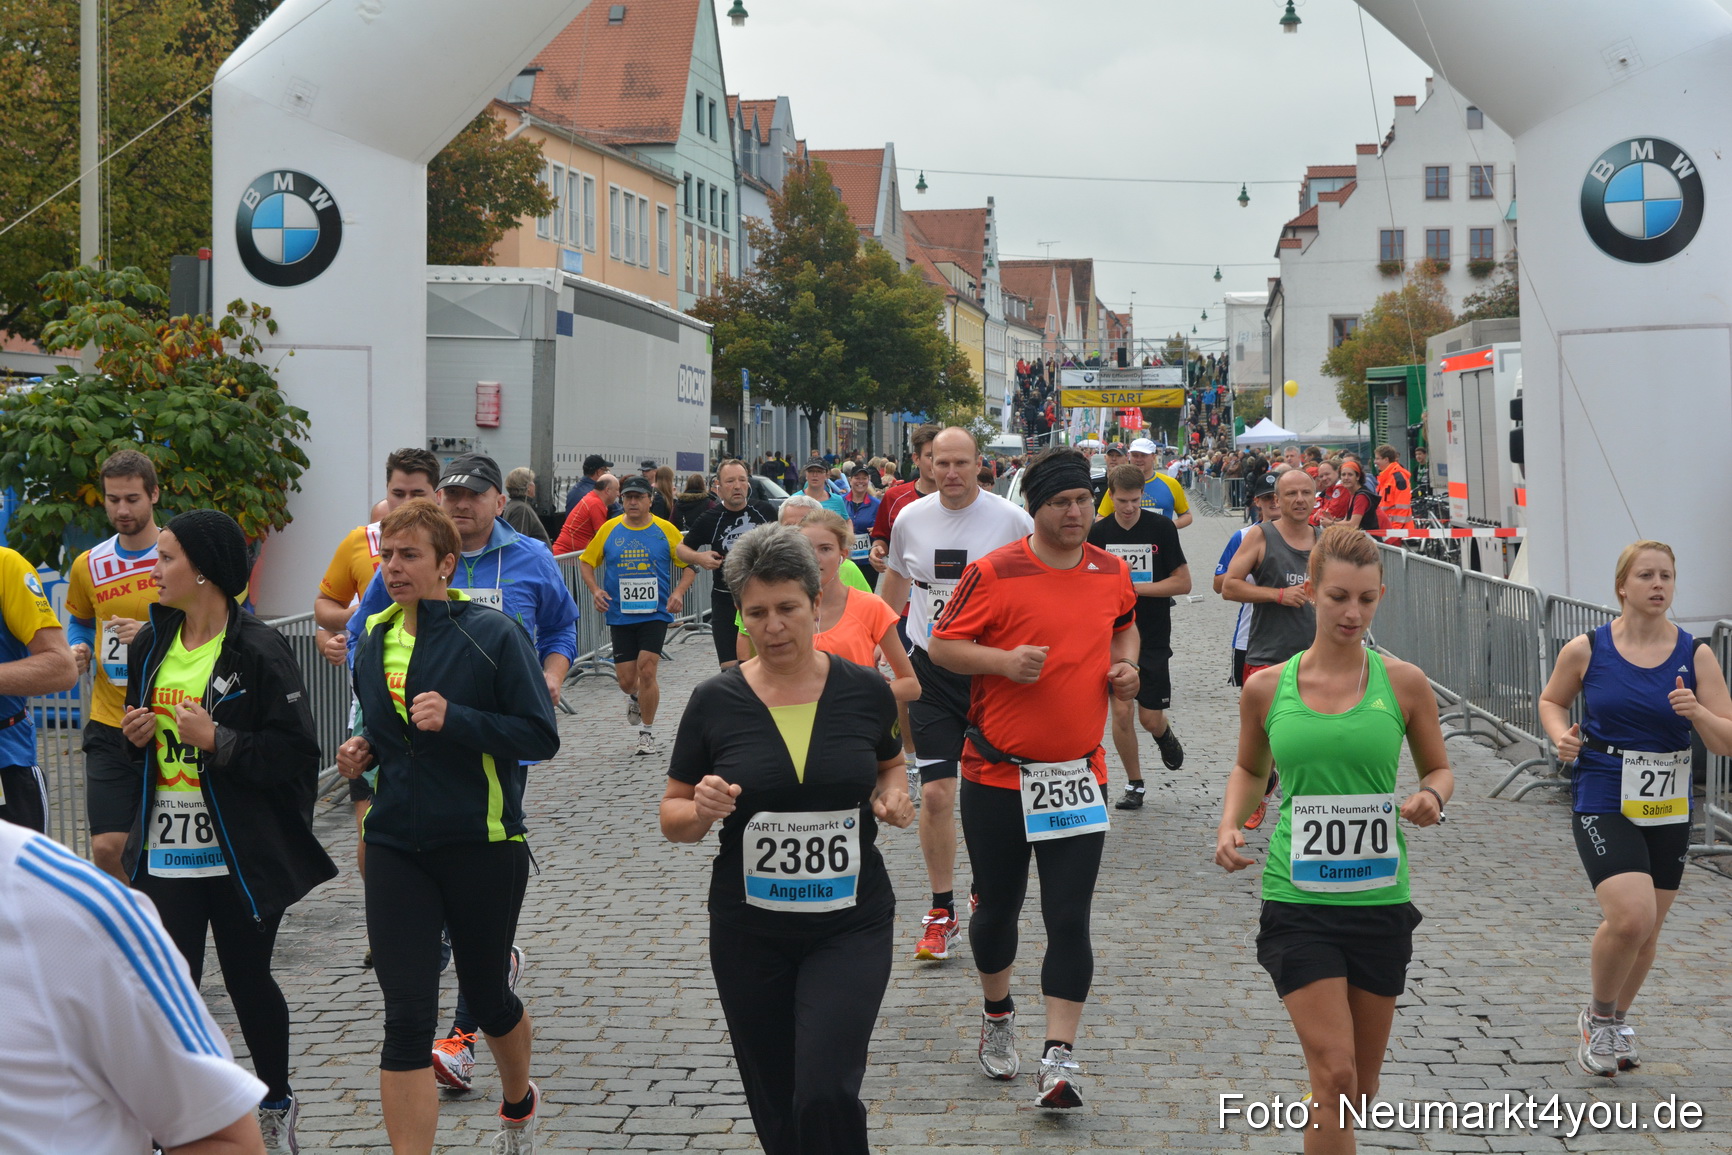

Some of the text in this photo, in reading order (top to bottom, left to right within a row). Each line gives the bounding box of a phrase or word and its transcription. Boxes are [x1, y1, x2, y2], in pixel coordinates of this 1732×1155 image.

[1590, 140, 1696, 184] BMW
[242, 172, 334, 211] BMW
[678, 364, 705, 406] BOCK
[1101, 392, 1144, 403] START
[95, 583, 132, 604] MAX
[623, 586, 655, 600] 3420
[933, 599, 944, 620] 2
[108, 637, 120, 660] 2
[115, 665, 128, 677] Ma
[1624, 757, 1651, 766] PARTL
[1023, 768, 1084, 778] PARTL Neumarkt
[1030, 776, 1095, 810] 2536
[1294, 804, 1379, 814] PARTL Neumarkt
[1642, 803, 1673, 815] Sabrina
[158, 812, 213, 844] 278
[747, 820, 839, 832] PARTL Neumarkt
[1049, 814, 1087, 827] Florian
[1303, 818, 1388, 855] 2070
[756, 834, 849, 874] 2386
[1319, 864, 1372, 879] Carmen
[769, 884, 833, 901] Angelika
